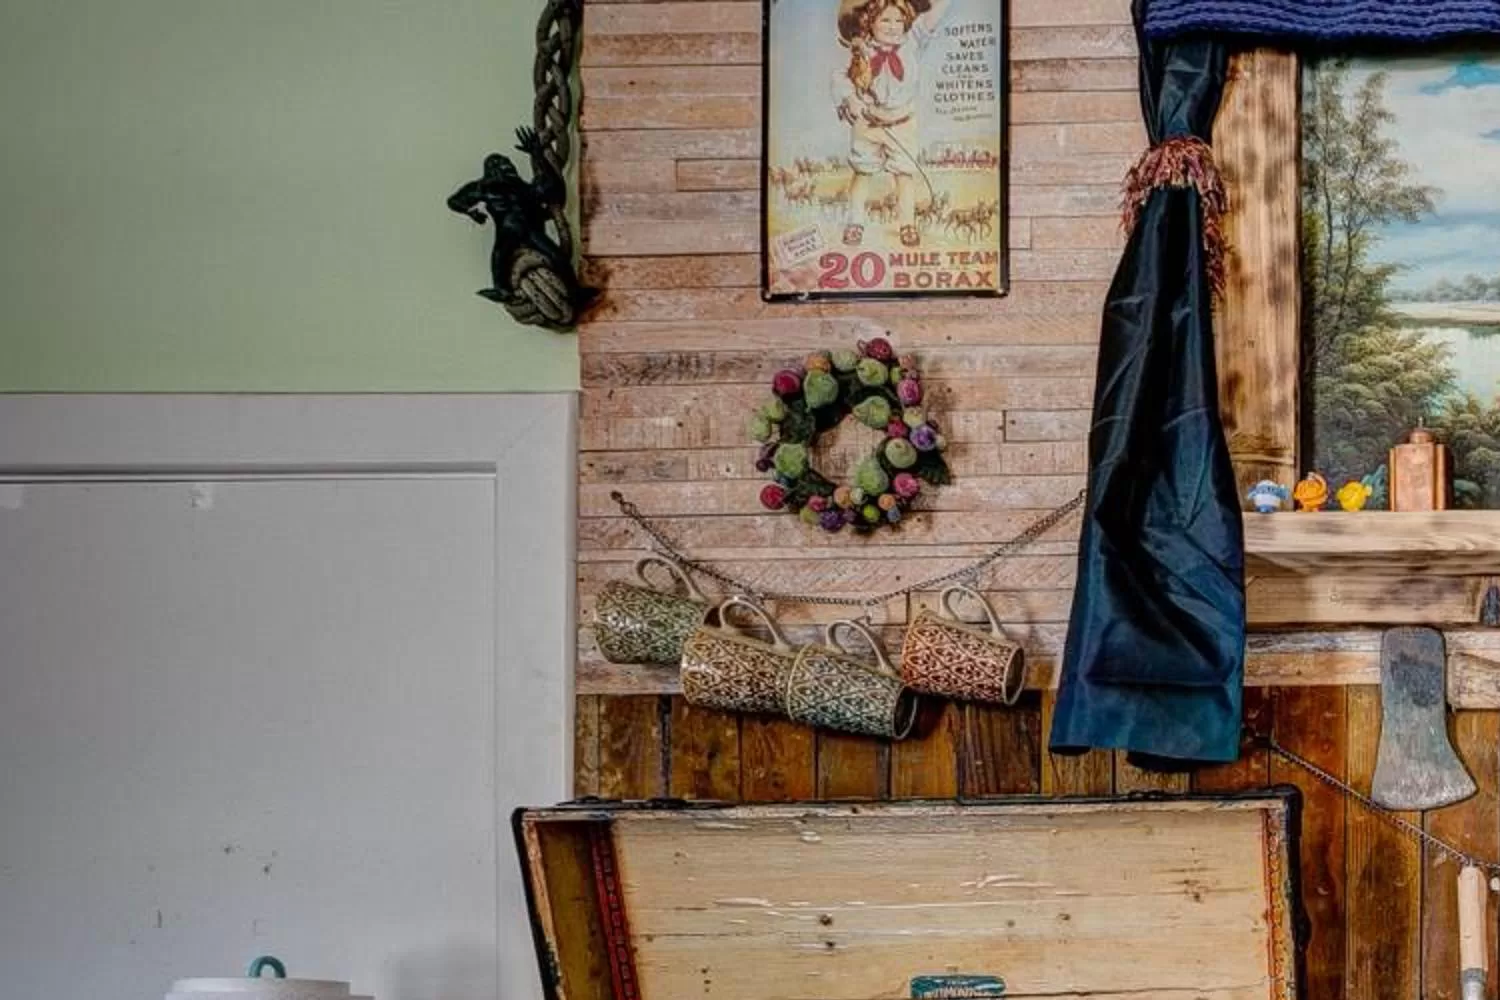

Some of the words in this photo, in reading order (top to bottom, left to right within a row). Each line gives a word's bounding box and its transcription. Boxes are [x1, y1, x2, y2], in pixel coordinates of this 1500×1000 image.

[943, 23, 993, 37] SOFTENS
[959, 36, 997, 49] WATER
[945, 51, 984, 61] SAVES
[941, 63, 989, 74] CLEANS
[935, 79, 993, 89] WHITENS
[933, 91, 995, 102] CLOTHES
[818, 251, 886, 289] 20
[889, 252, 941, 268] MULE
[947, 251, 999, 266] TEAM
[893, 271, 994, 289] BORAX
